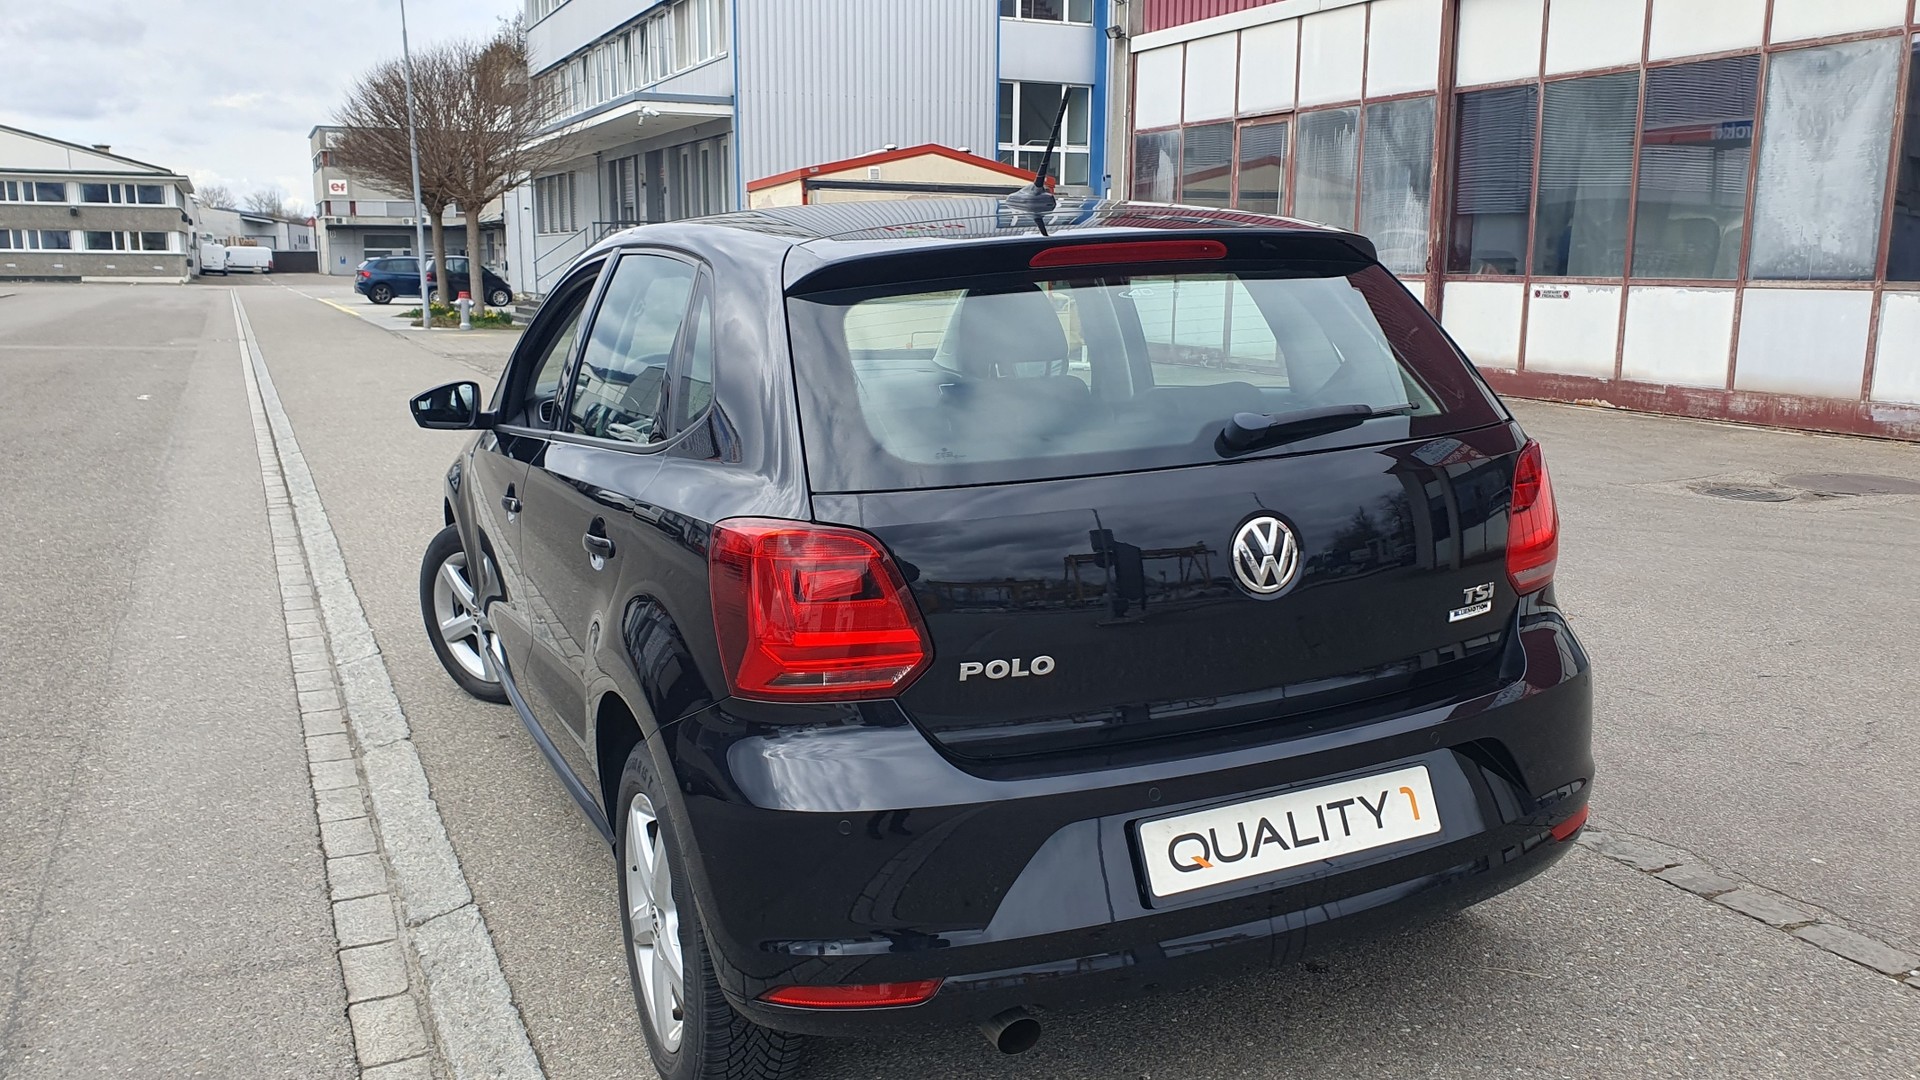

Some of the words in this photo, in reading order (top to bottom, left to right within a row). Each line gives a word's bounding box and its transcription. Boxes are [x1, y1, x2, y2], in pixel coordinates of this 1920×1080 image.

[959, 655, 1056, 682] POLO
[1168, 790, 1389, 873] QUALITY
[1399, 786, 1421, 821] 1
